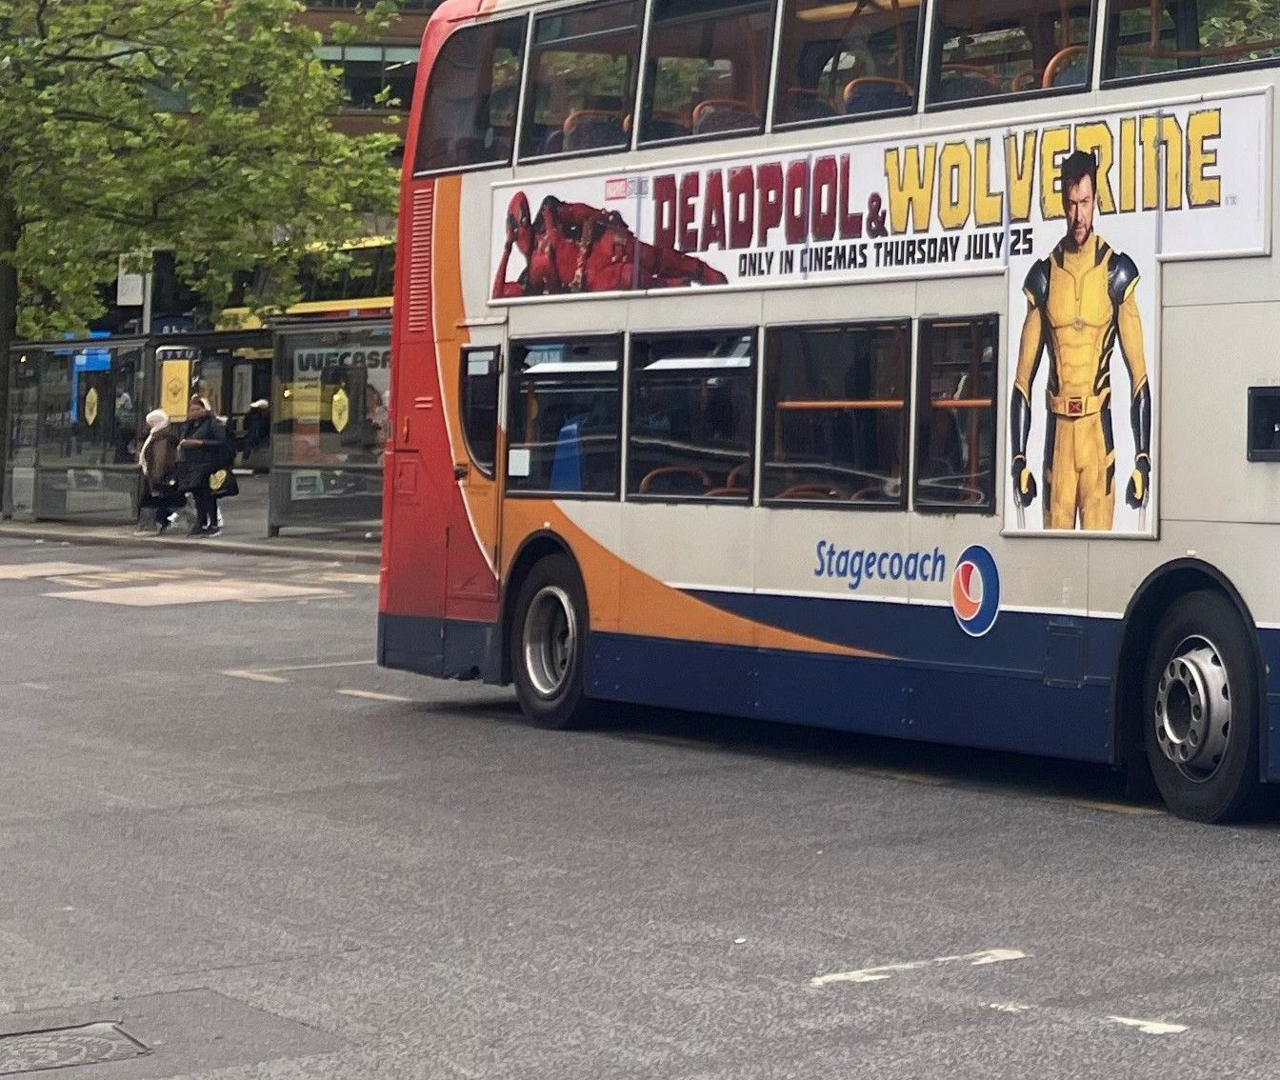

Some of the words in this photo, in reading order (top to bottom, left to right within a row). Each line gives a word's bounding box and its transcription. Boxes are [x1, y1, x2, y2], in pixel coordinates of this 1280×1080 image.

[652, 152, 863, 252] DEADPOOL
[866, 191, 889, 238] &
[884, 107, 1222, 236] WOLVERINE
[738, 252, 774, 277] ONLY
[779, 249, 794, 274] IN
[800, 243, 868, 273] CINEMAS
[874, 235, 959, 267] THURSDAY
[964, 231, 1005, 261] JULY
[1009, 228, 1034, 256] 25
[814, 540, 946, 590] Stagecoach
